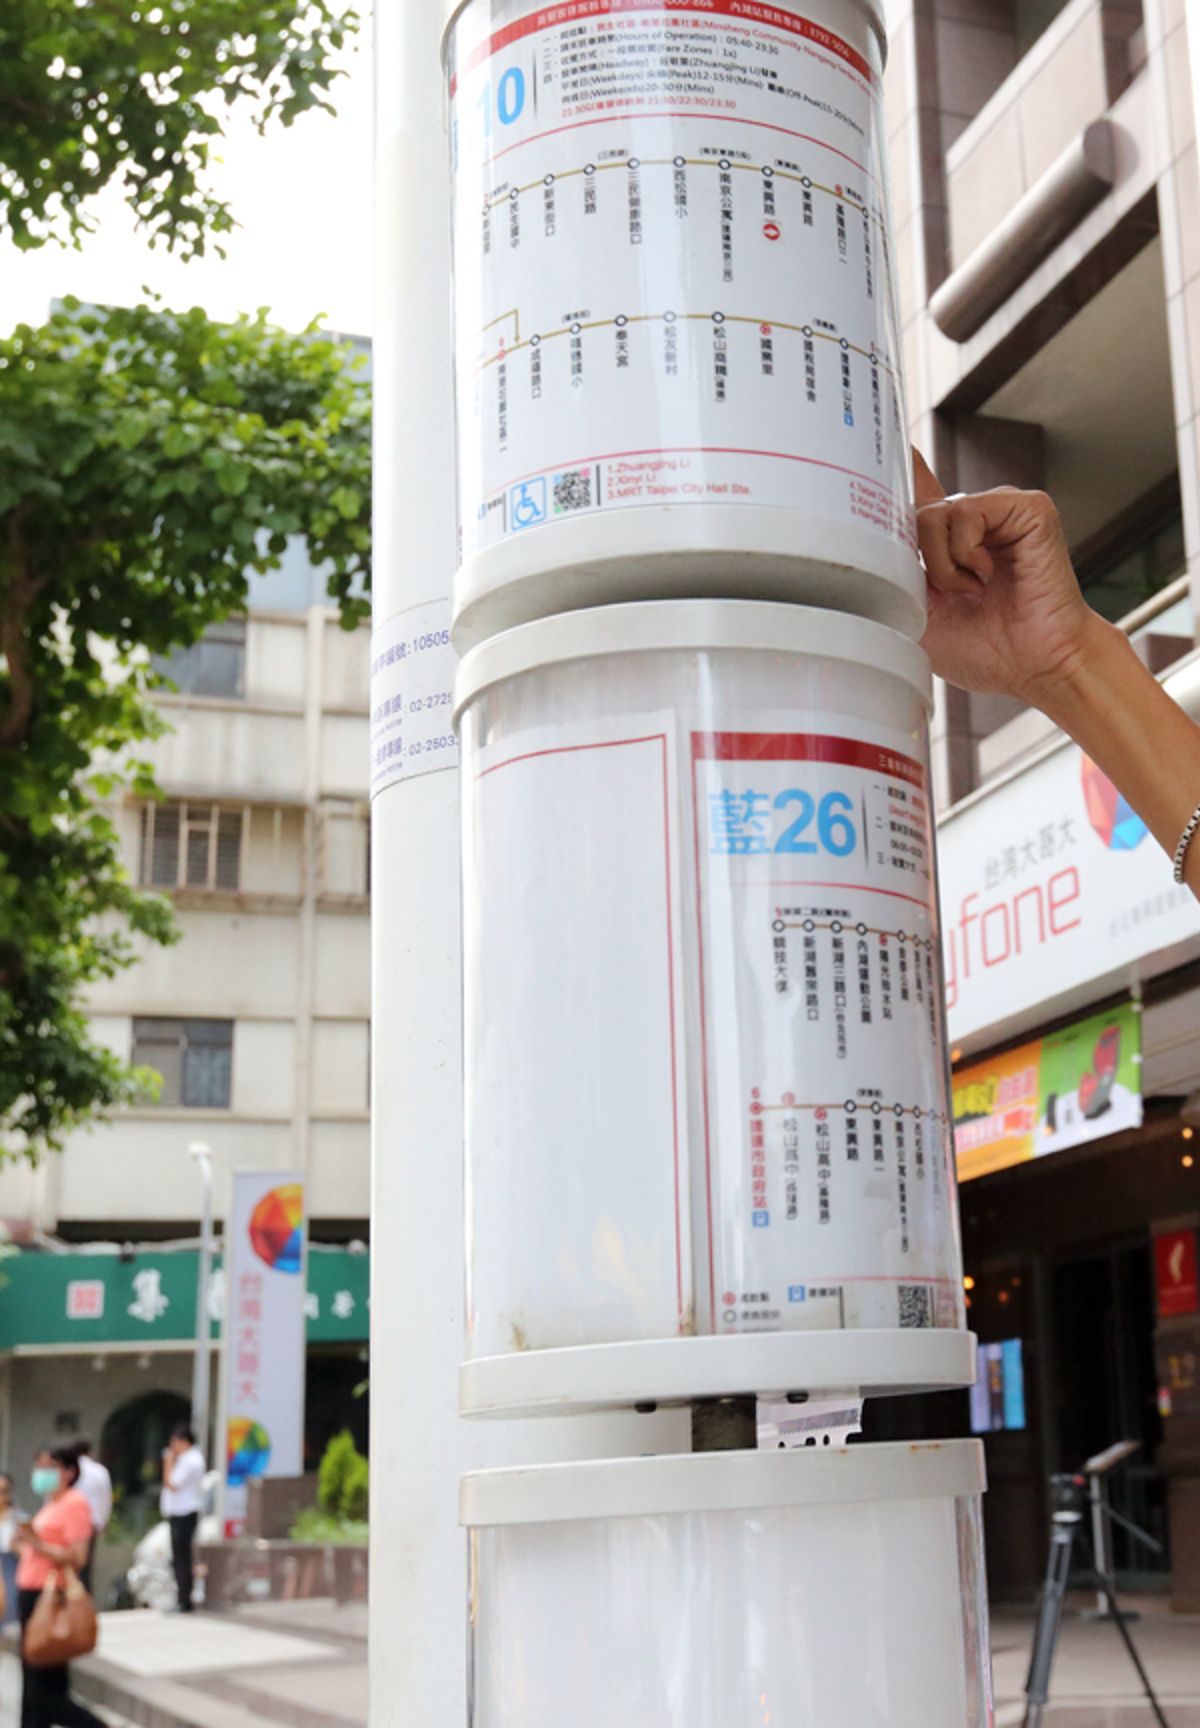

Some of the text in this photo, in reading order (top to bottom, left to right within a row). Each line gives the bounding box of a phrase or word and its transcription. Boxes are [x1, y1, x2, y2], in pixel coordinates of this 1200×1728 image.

[709, 788, 857, 857] 藍26
[750, 1119, 768, 1209] 捷運市政府站
